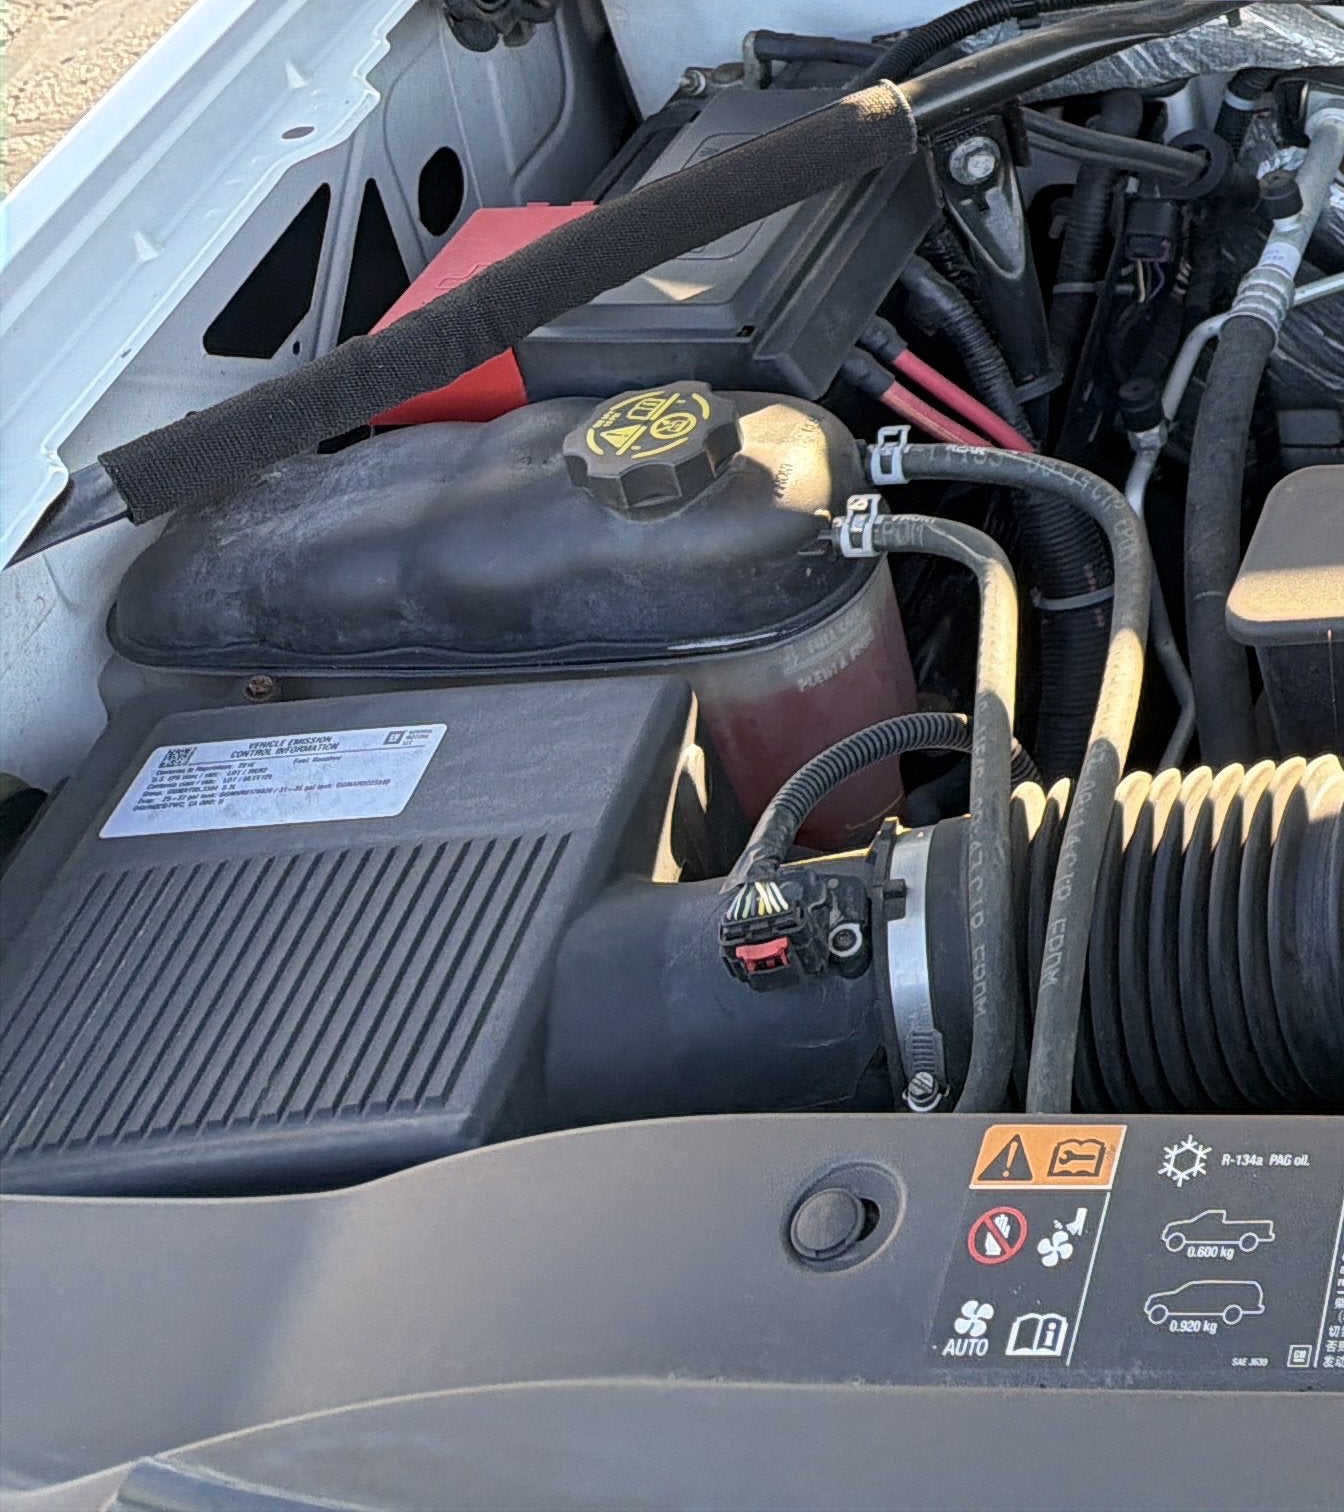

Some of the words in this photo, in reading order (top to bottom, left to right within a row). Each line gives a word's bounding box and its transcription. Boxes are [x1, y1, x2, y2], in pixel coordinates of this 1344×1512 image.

[248, 739, 284, 749] VEHICLE
[287, 736, 333, 746] EMISSION
[230, 749, 271, 758] CONTROL
[275, 742, 339, 755] INFORMATION
[1221, 1153, 1263, 1166] R-134a
[1269, 1153, 1292, 1166] PAG
[1293, 1154, 1310, 1166] oil.
[1187, 1246, 1218, 1258] 0.600
[1220, 1246, 1235, 1260] kg
[1169, 1320, 1201, 1332] 0.920
[1203, 1320, 1218, 1335] kg
[942, 1338, 989, 1356] AUTO
